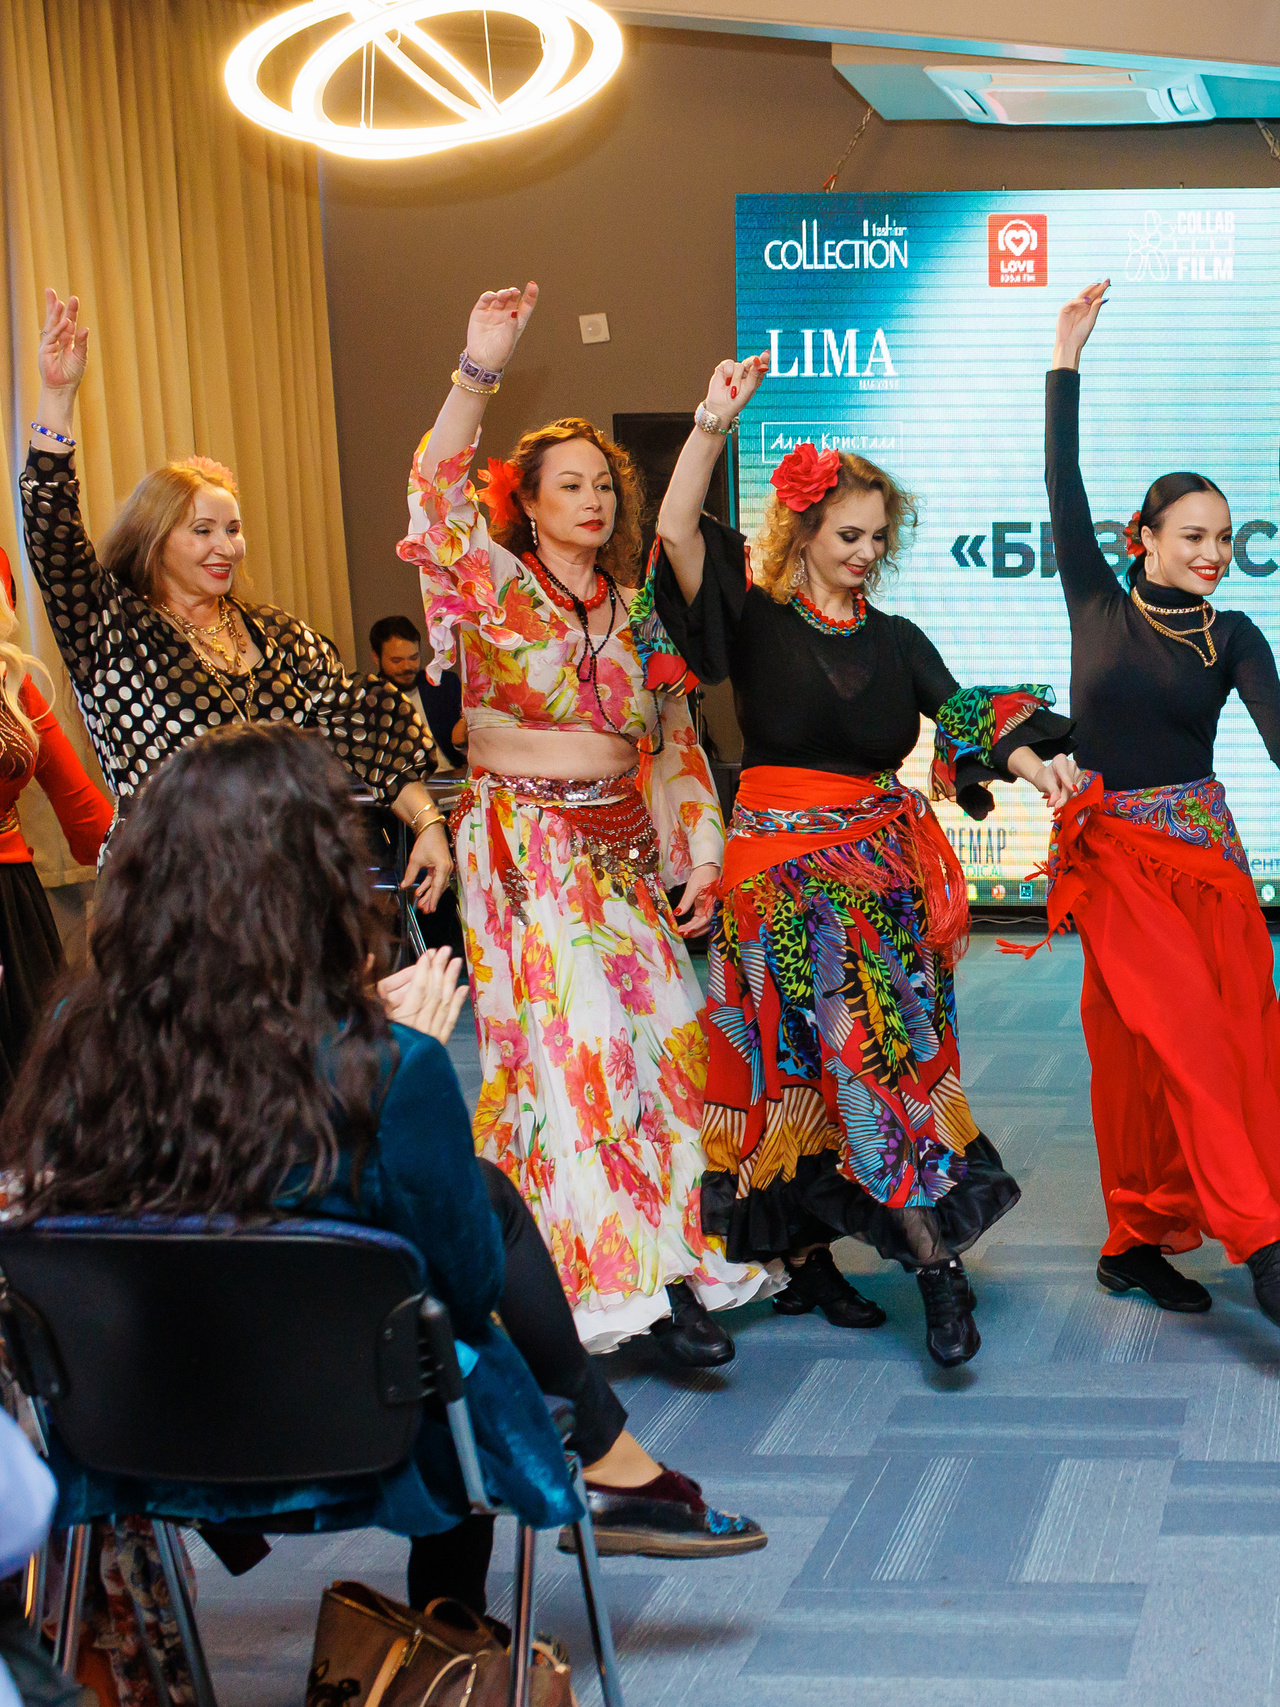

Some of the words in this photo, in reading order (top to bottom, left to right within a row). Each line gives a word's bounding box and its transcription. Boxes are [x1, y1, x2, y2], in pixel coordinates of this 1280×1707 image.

[1178, 211, 1235, 234] COLLAB
[1000, 260, 1035, 273] LOVE
[1178, 257, 1234, 281] FILM
[766, 328, 899, 378] LIMA
